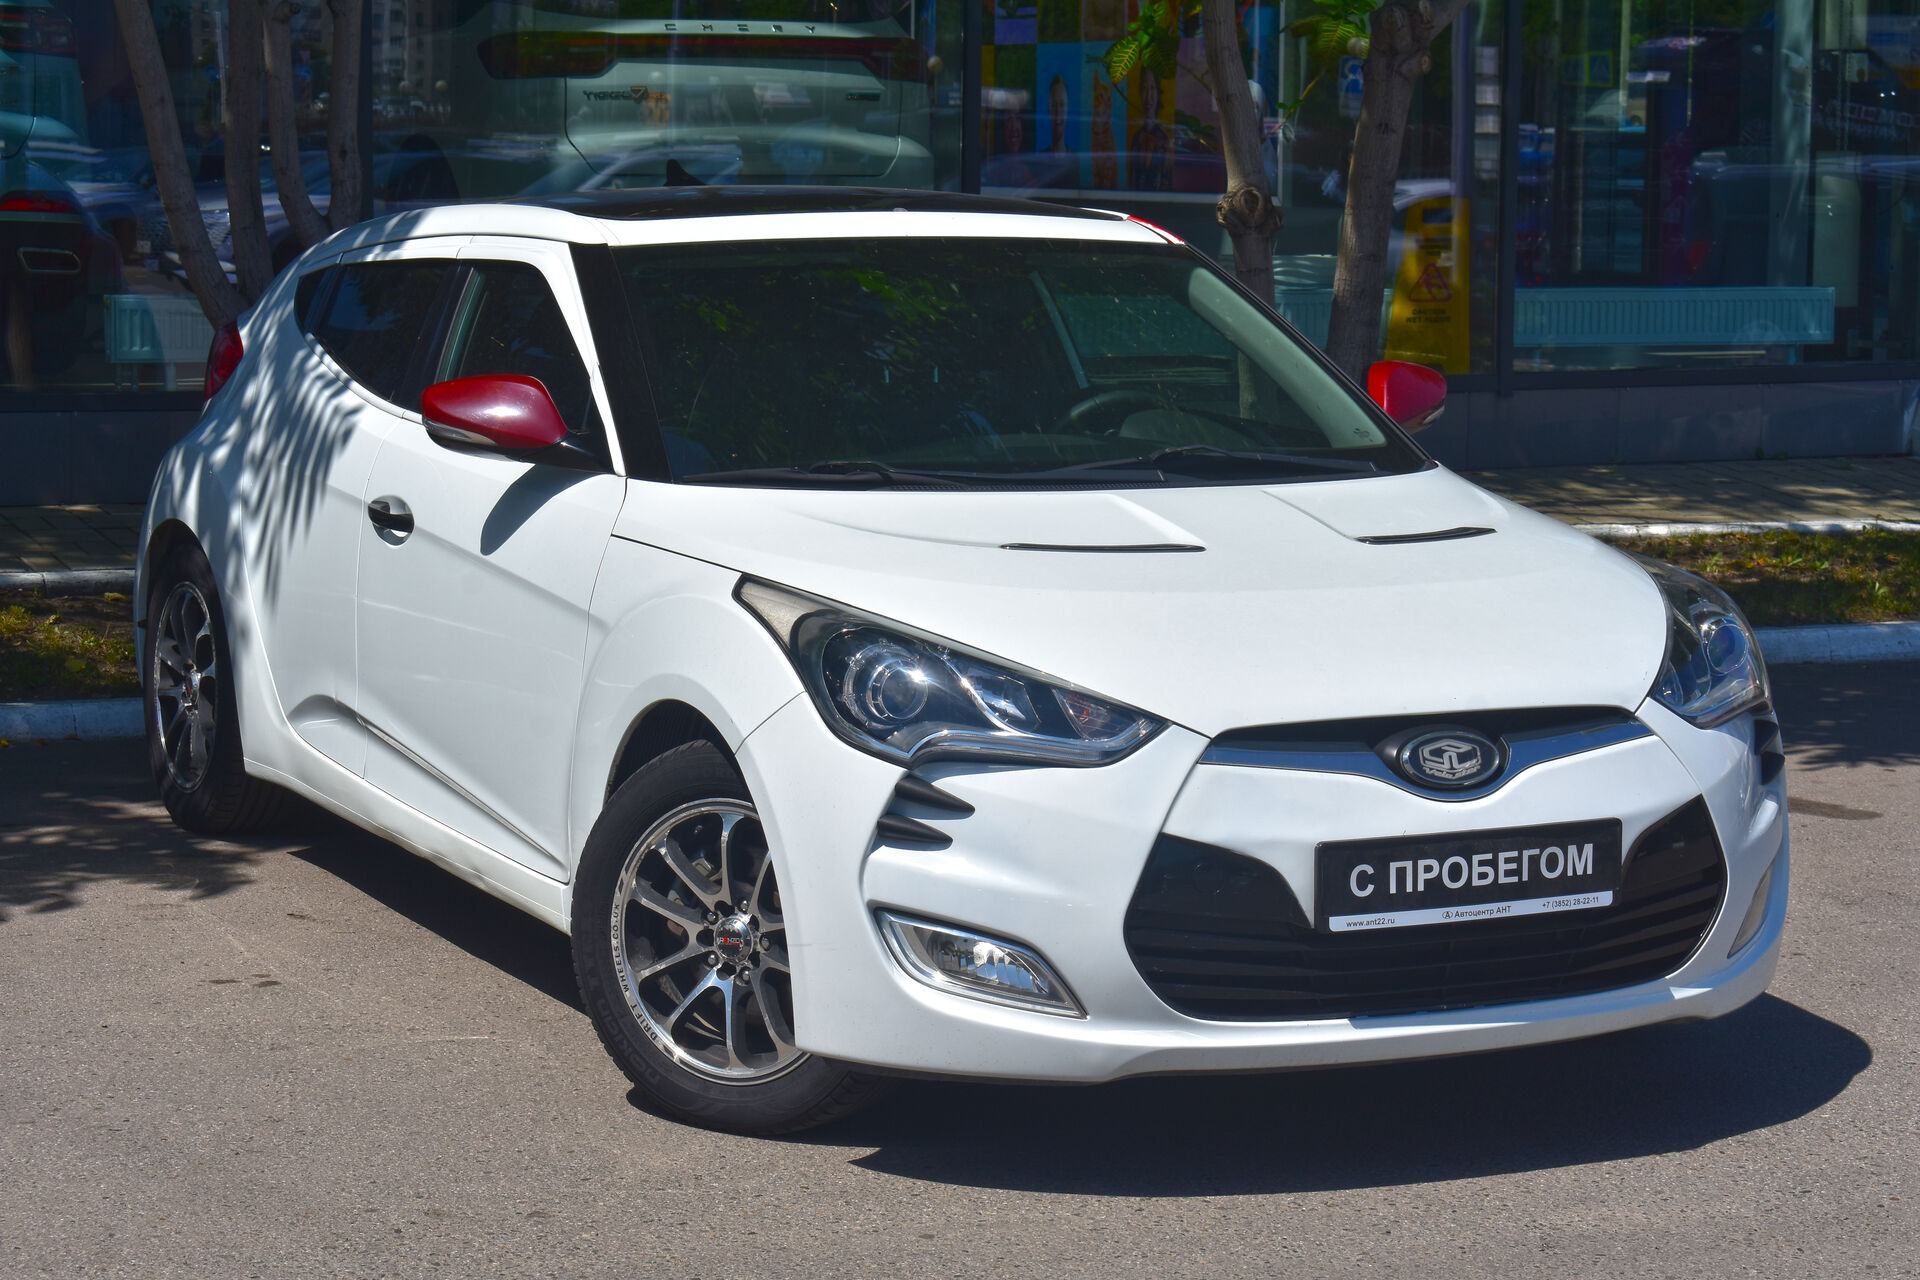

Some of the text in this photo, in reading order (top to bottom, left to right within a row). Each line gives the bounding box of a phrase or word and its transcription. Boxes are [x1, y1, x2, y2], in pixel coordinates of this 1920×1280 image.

[664, 23, 816, 34] CHERY
[1350, 843, 1593, 897] С ПРОБЕГОМ
[1542, 896, 1599, 909] +7 (3852) 28-22-11
[1454, 907, 1494, 918] Автоцентр
[1496, 905, 1512, 914] АНТ
[1346, 917, 1395, 928] www.ant22.ru
[630, 1003, 658, 1041] DRIFT
